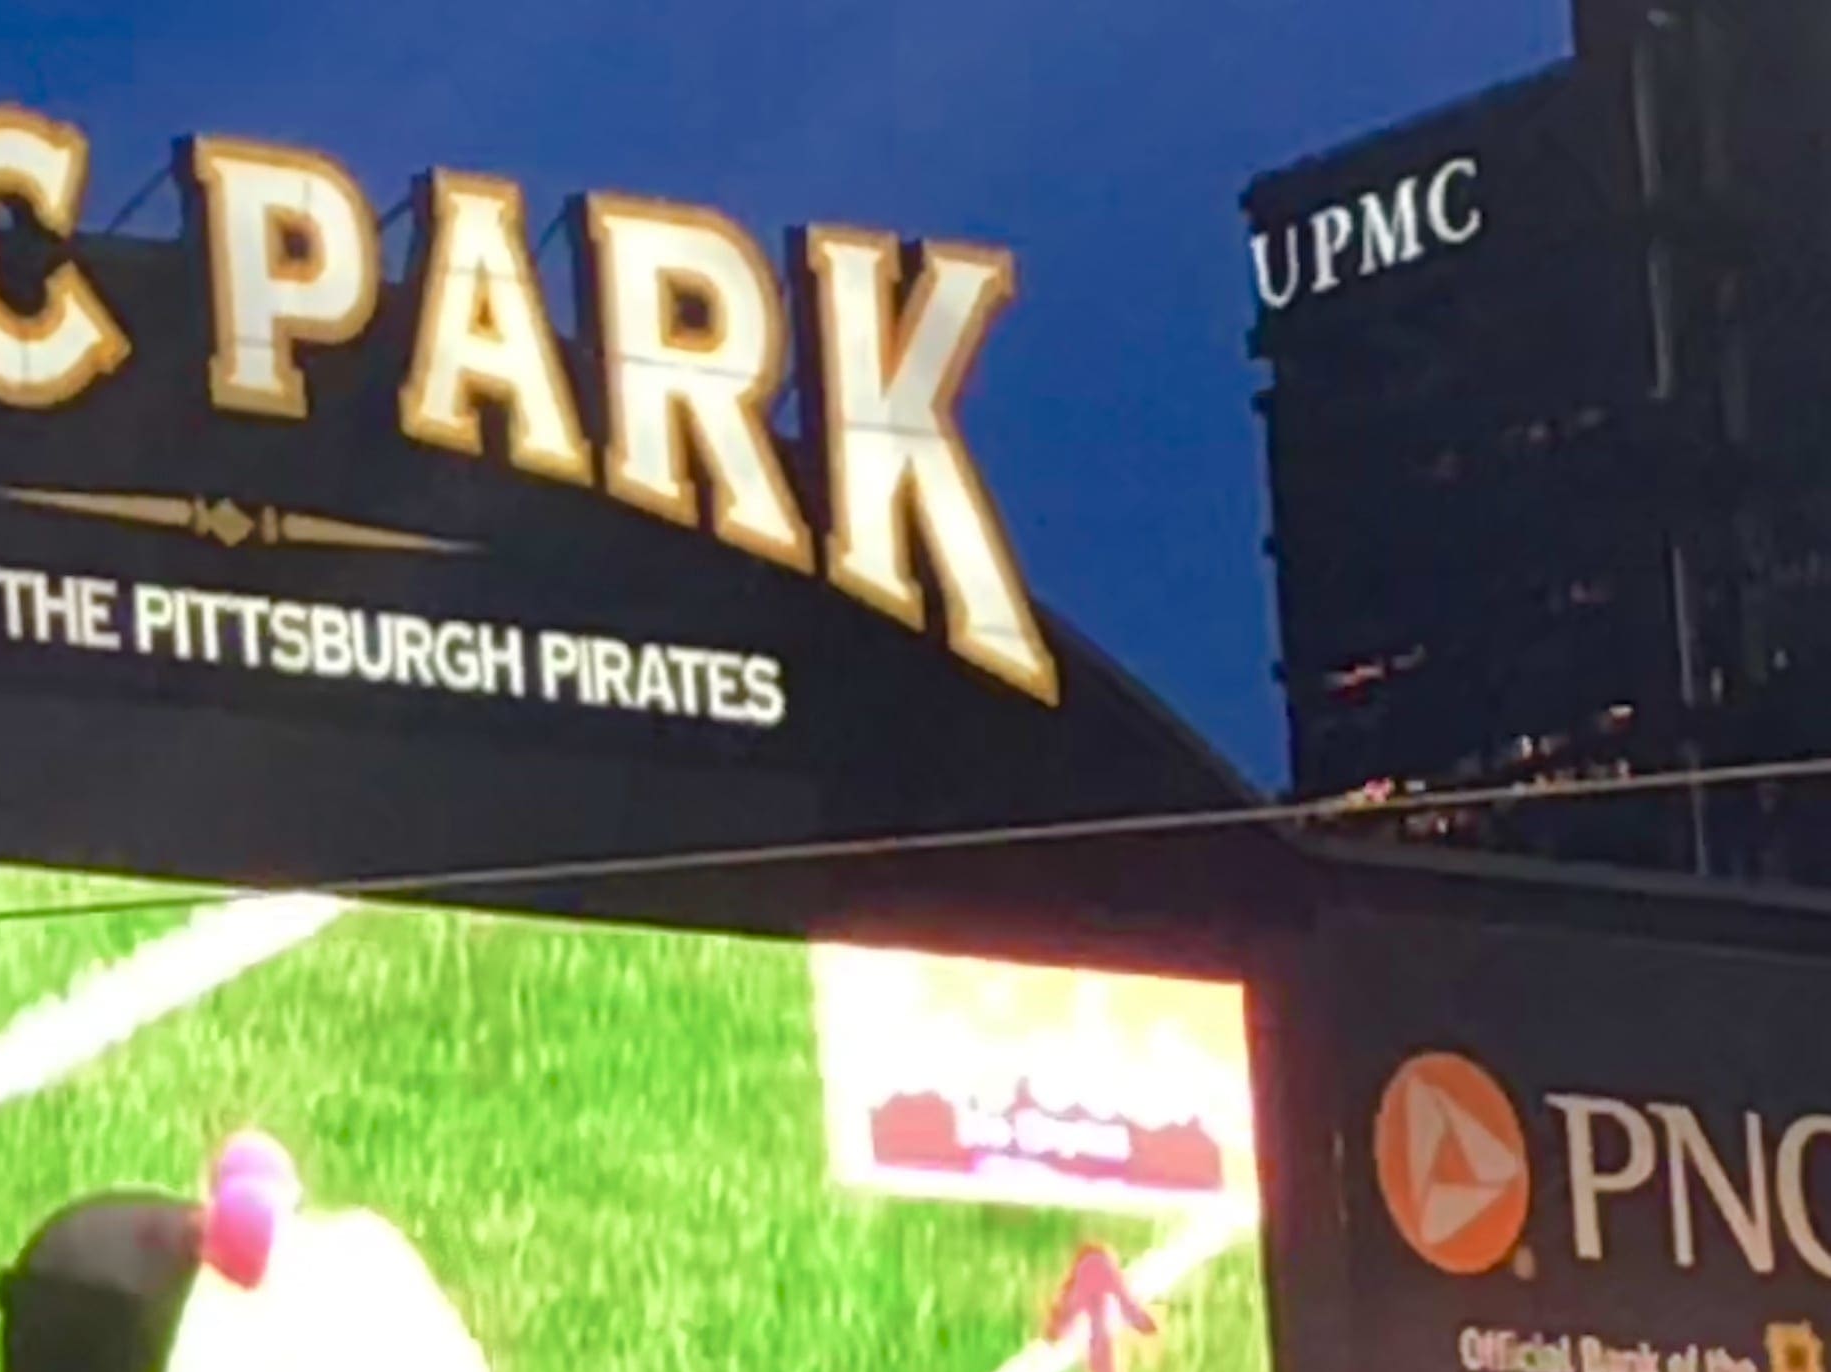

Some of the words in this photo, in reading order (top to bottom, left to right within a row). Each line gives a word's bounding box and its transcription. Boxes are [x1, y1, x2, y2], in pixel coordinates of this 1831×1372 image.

[1249, 158, 1482, 310] UPMC
[189, 130, 1060, 708] PARK
[133, 582, 527, 698] PITTSBURGH
[538, 630, 787, 728] PIRATES
[1542, 1092, 1831, 1282] PNC
